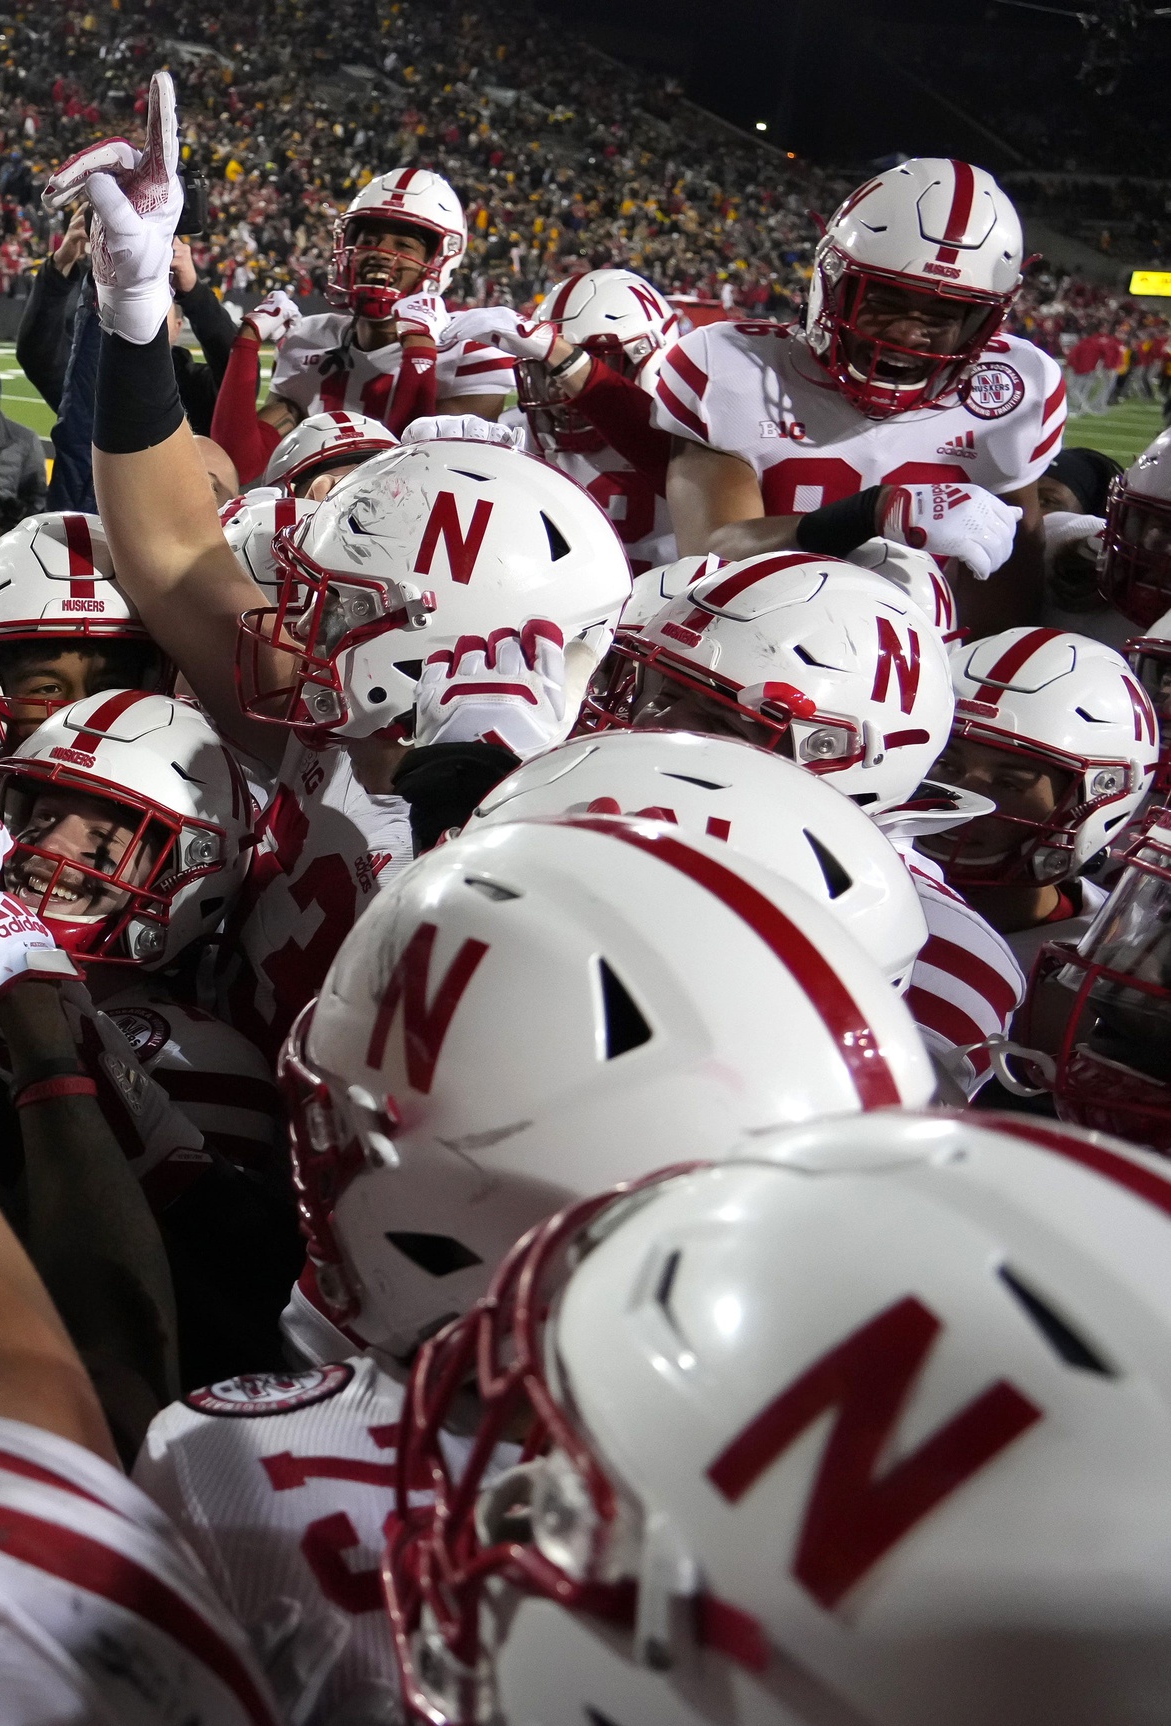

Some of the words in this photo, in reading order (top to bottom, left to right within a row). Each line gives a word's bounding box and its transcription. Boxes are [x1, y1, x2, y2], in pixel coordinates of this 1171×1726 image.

[627, 284, 664, 321] N
[413, 490, 494, 585] N
[61, 599, 105, 613] HUSKERS
[927, 572, 951, 630] N
[870, 615, 920, 715] N
[49, 745, 97, 768] HUSKERS
[367, 922, 490, 1095] N
[706, 1294, 1044, 1612] N
